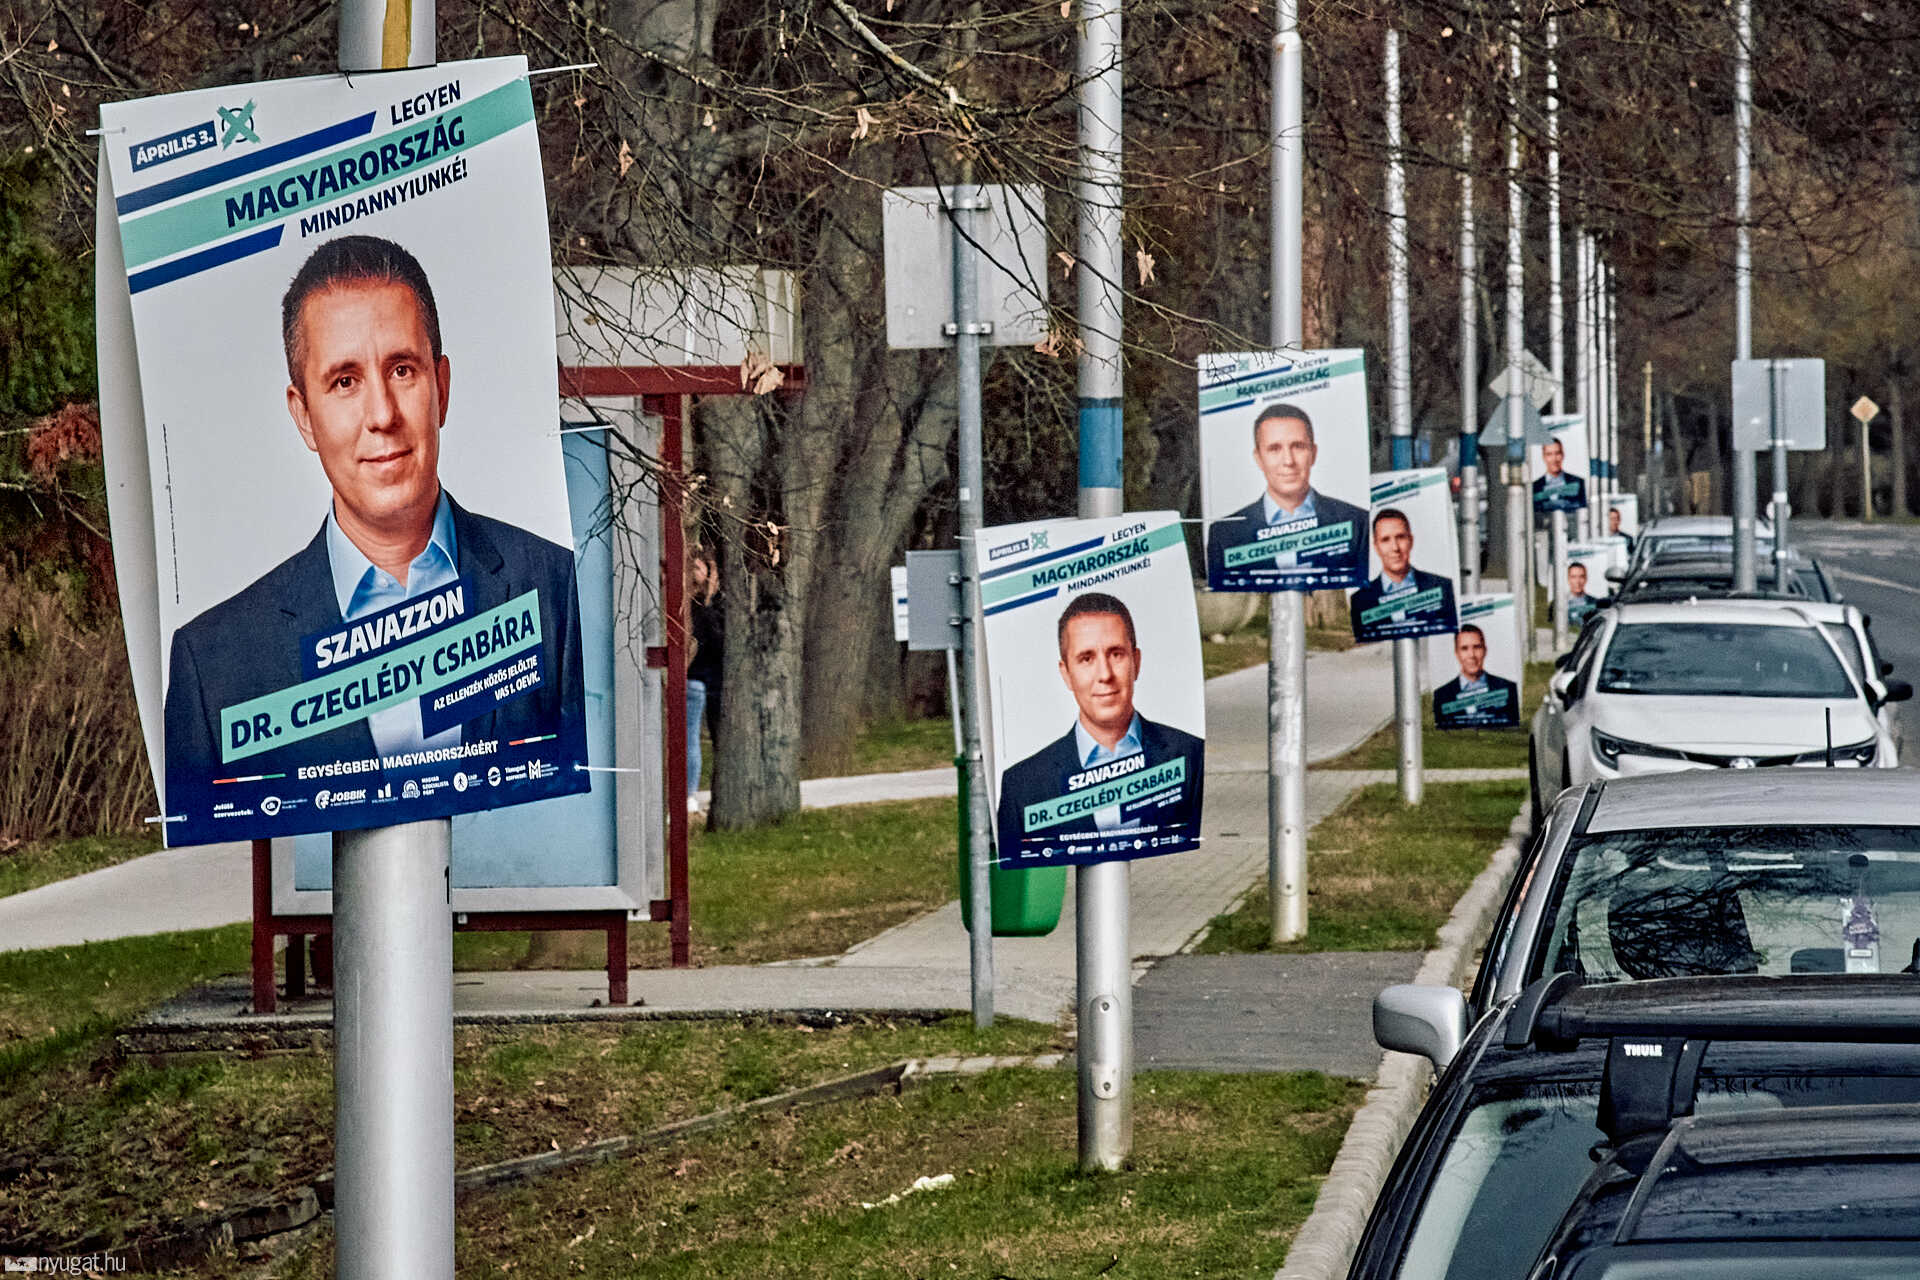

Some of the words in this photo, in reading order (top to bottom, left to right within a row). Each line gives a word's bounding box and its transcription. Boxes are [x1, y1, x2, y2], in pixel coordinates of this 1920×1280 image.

[391, 80, 461, 125] LEGYEN
[136, 135, 197, 165] ÁPRILIS
[199, 131, 213, 147] 3.
[225, 116, 465, 227] MAGYARORSZÁG
[300, 157, 468, 238] MINDANNYIUNKÉ!
[1236, 368, 1330, 397] MAGYARORSZÁG
[1112, 522, 1146, 542] LEGYEN
[1256, 517, 1318, 540] SZAVAZZON
[1032, 538, 1149, 588] MAGYARORSZÁG
[1067, 558, 1151, 593] MINDANNYIUNKÉ!
[316, 586, 465, 669] SZAVAZZON
[231, 713, 282, 749] DR.
[291, 655, 425, 729] CZEGLÉDY
[433, 610, 535, 676] CSABÁRA
[434, 697, 446, 711] AZ
[446, 680, 484, 705] ELLENZÉK
[484, 669, 508, 689] KÖZÖS
[494, 686, 510, 701] VAS
[515, 670, 541, 692] OEVK.
[298, 755, 379, 780] EGYSÉGBEN
[383, 740, 499, 769] MAGYARORSZÁGÉRT
[1068, 754, 1145, 791] SZAVAZZON
[330, 789, 367, 803] JOBBIK
[1028, 812, 1053, 826] DR.
[1057, 785, 1124, 817] CZEGLÉDY
[1127, 766, 1181, 796] CSABÁRA
[1624, 1044, 1662, 1056] THULE
